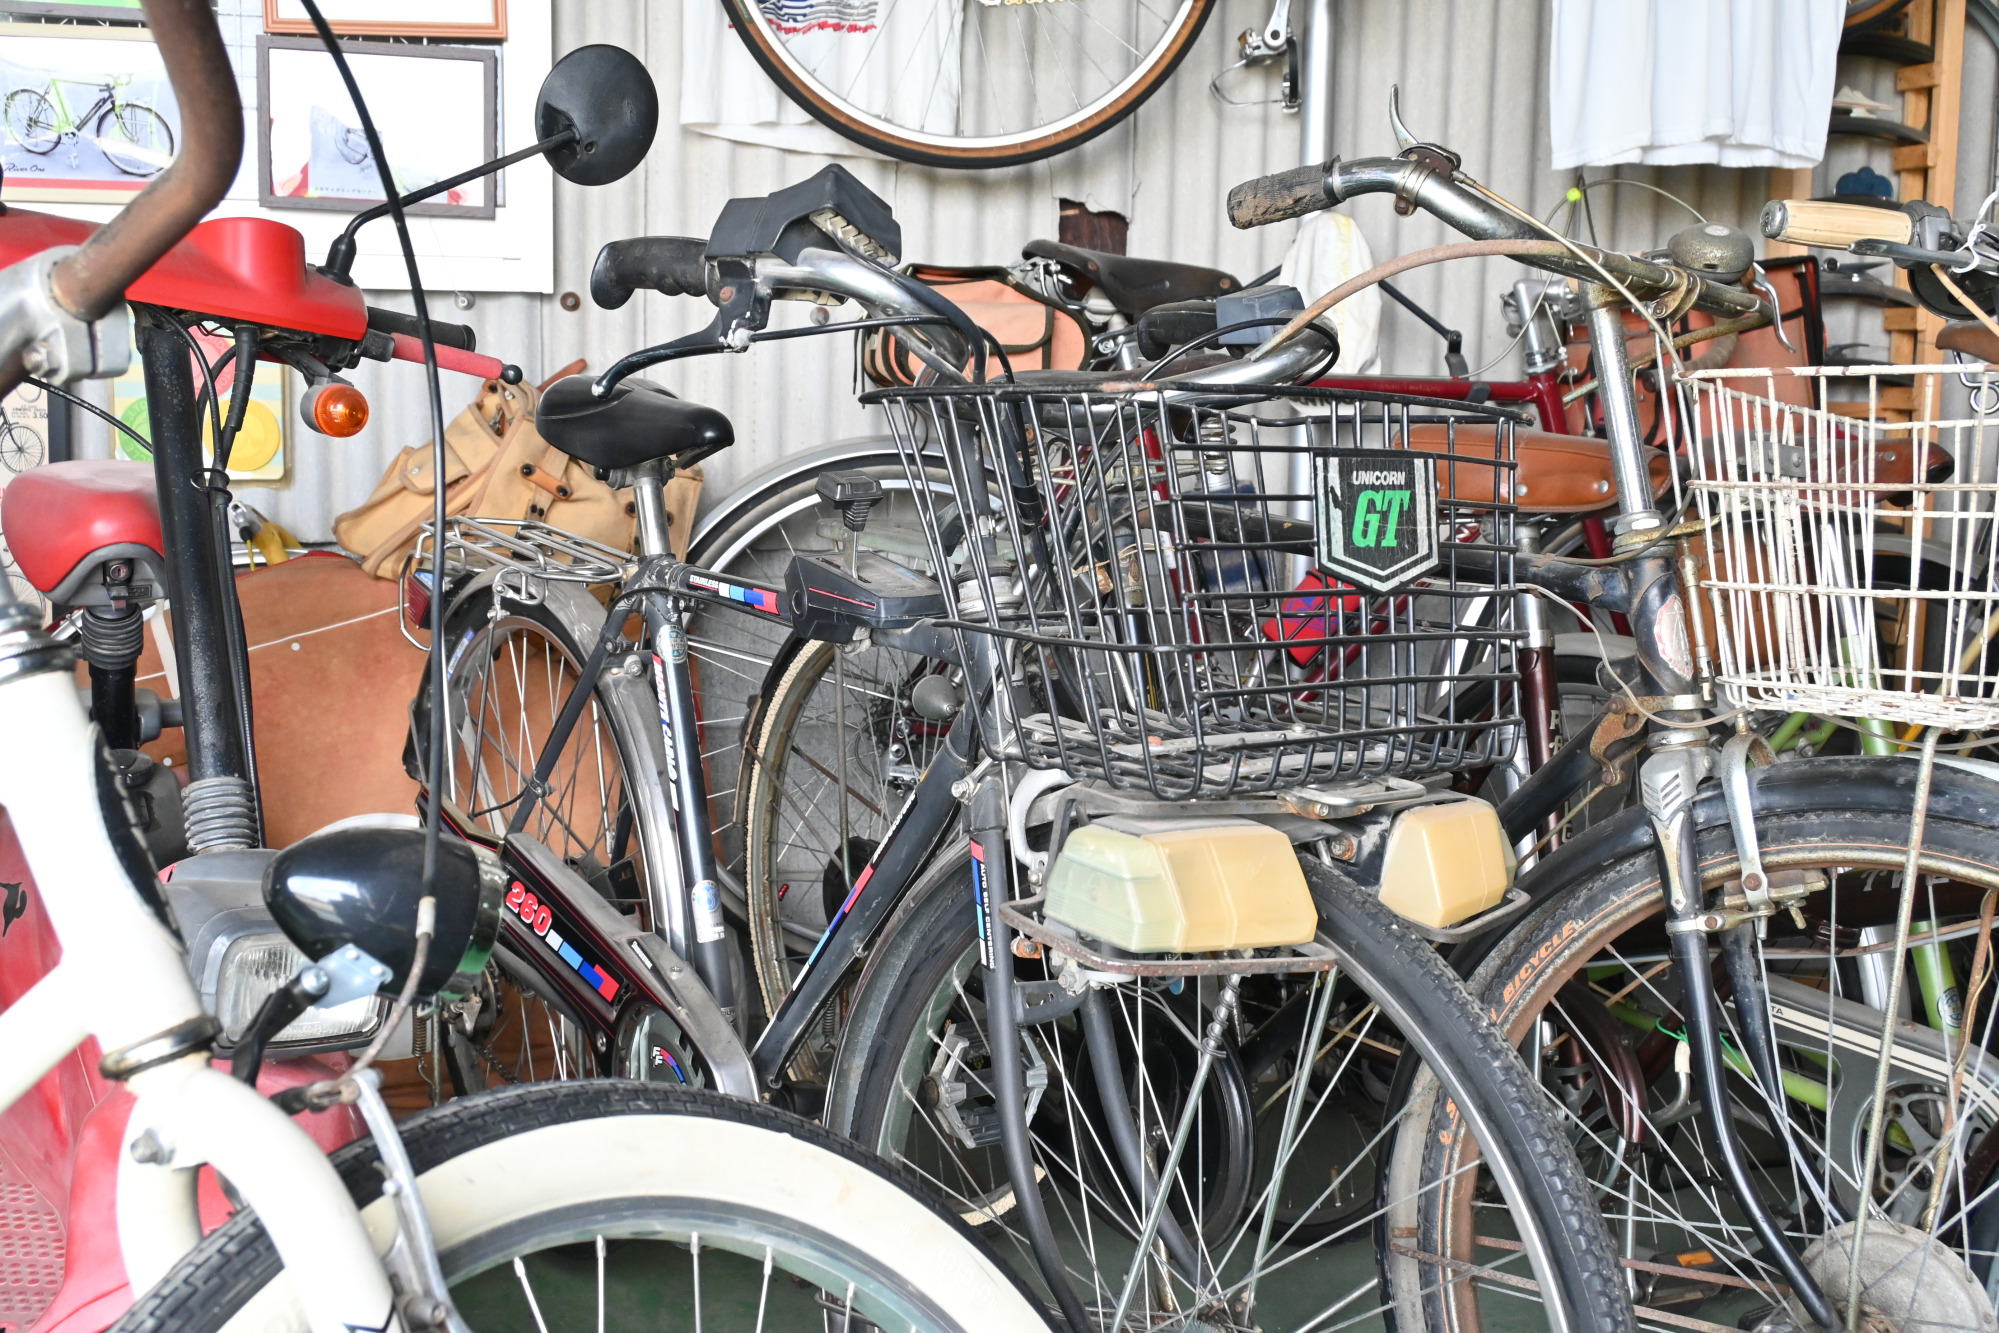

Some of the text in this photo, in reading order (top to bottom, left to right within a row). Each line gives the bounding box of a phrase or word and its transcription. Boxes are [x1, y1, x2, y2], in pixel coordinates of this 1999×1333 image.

[1352, 470, 1406, 486] UNICORN
[1351, 489, 1411, 548] GT
[689, 574, 719, 589] STAINLESS
[505, 881, 552, 937] 260
[979, 863, 996, 970] AUTO SELF CENTERING
[1503, 919, 1574, 1004] BICYCLE
